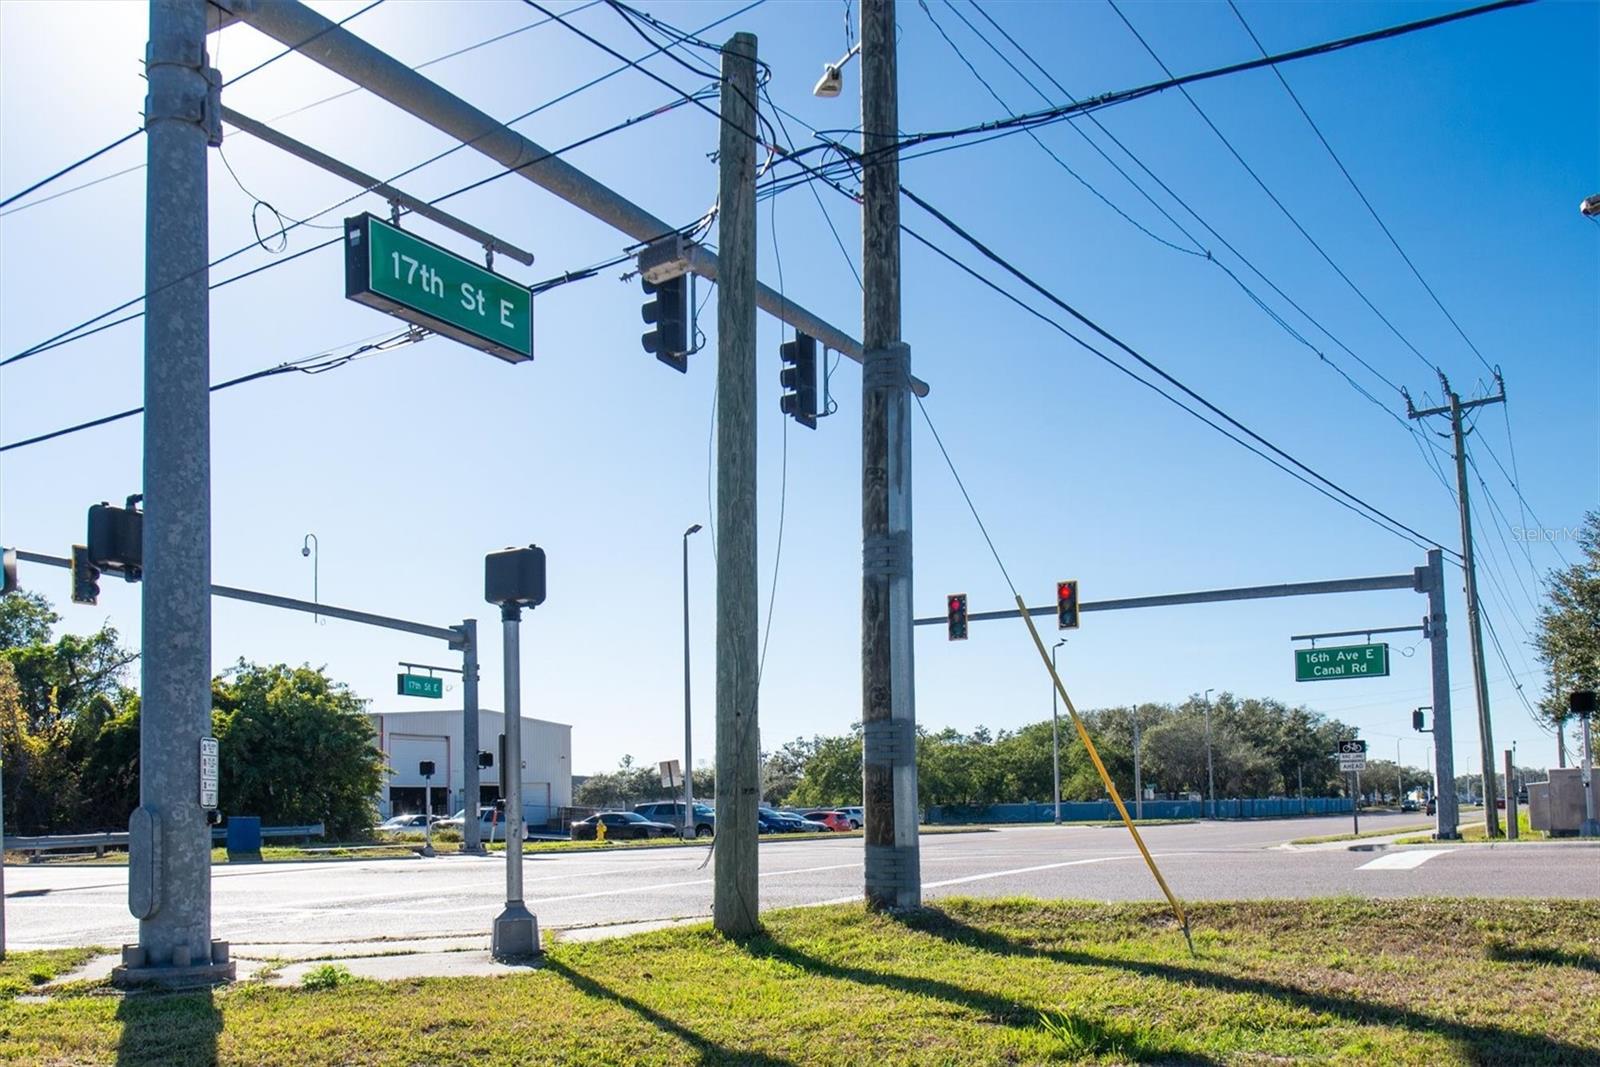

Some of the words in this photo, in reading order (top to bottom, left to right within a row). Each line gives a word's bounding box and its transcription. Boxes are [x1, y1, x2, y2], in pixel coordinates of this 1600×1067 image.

[392, 251, 444, 298] 17th
[461, 282, 486, 316] St
[500, 299, 515, 329] E
[1306, 652, 1330, 663] 16th
[1336, 651, 1359, 661] Ave
[1366, 649, 1374, 659] E
[1313, 664, 1345, 676] Canal
[1351, 663, 1367, 673] Rd
